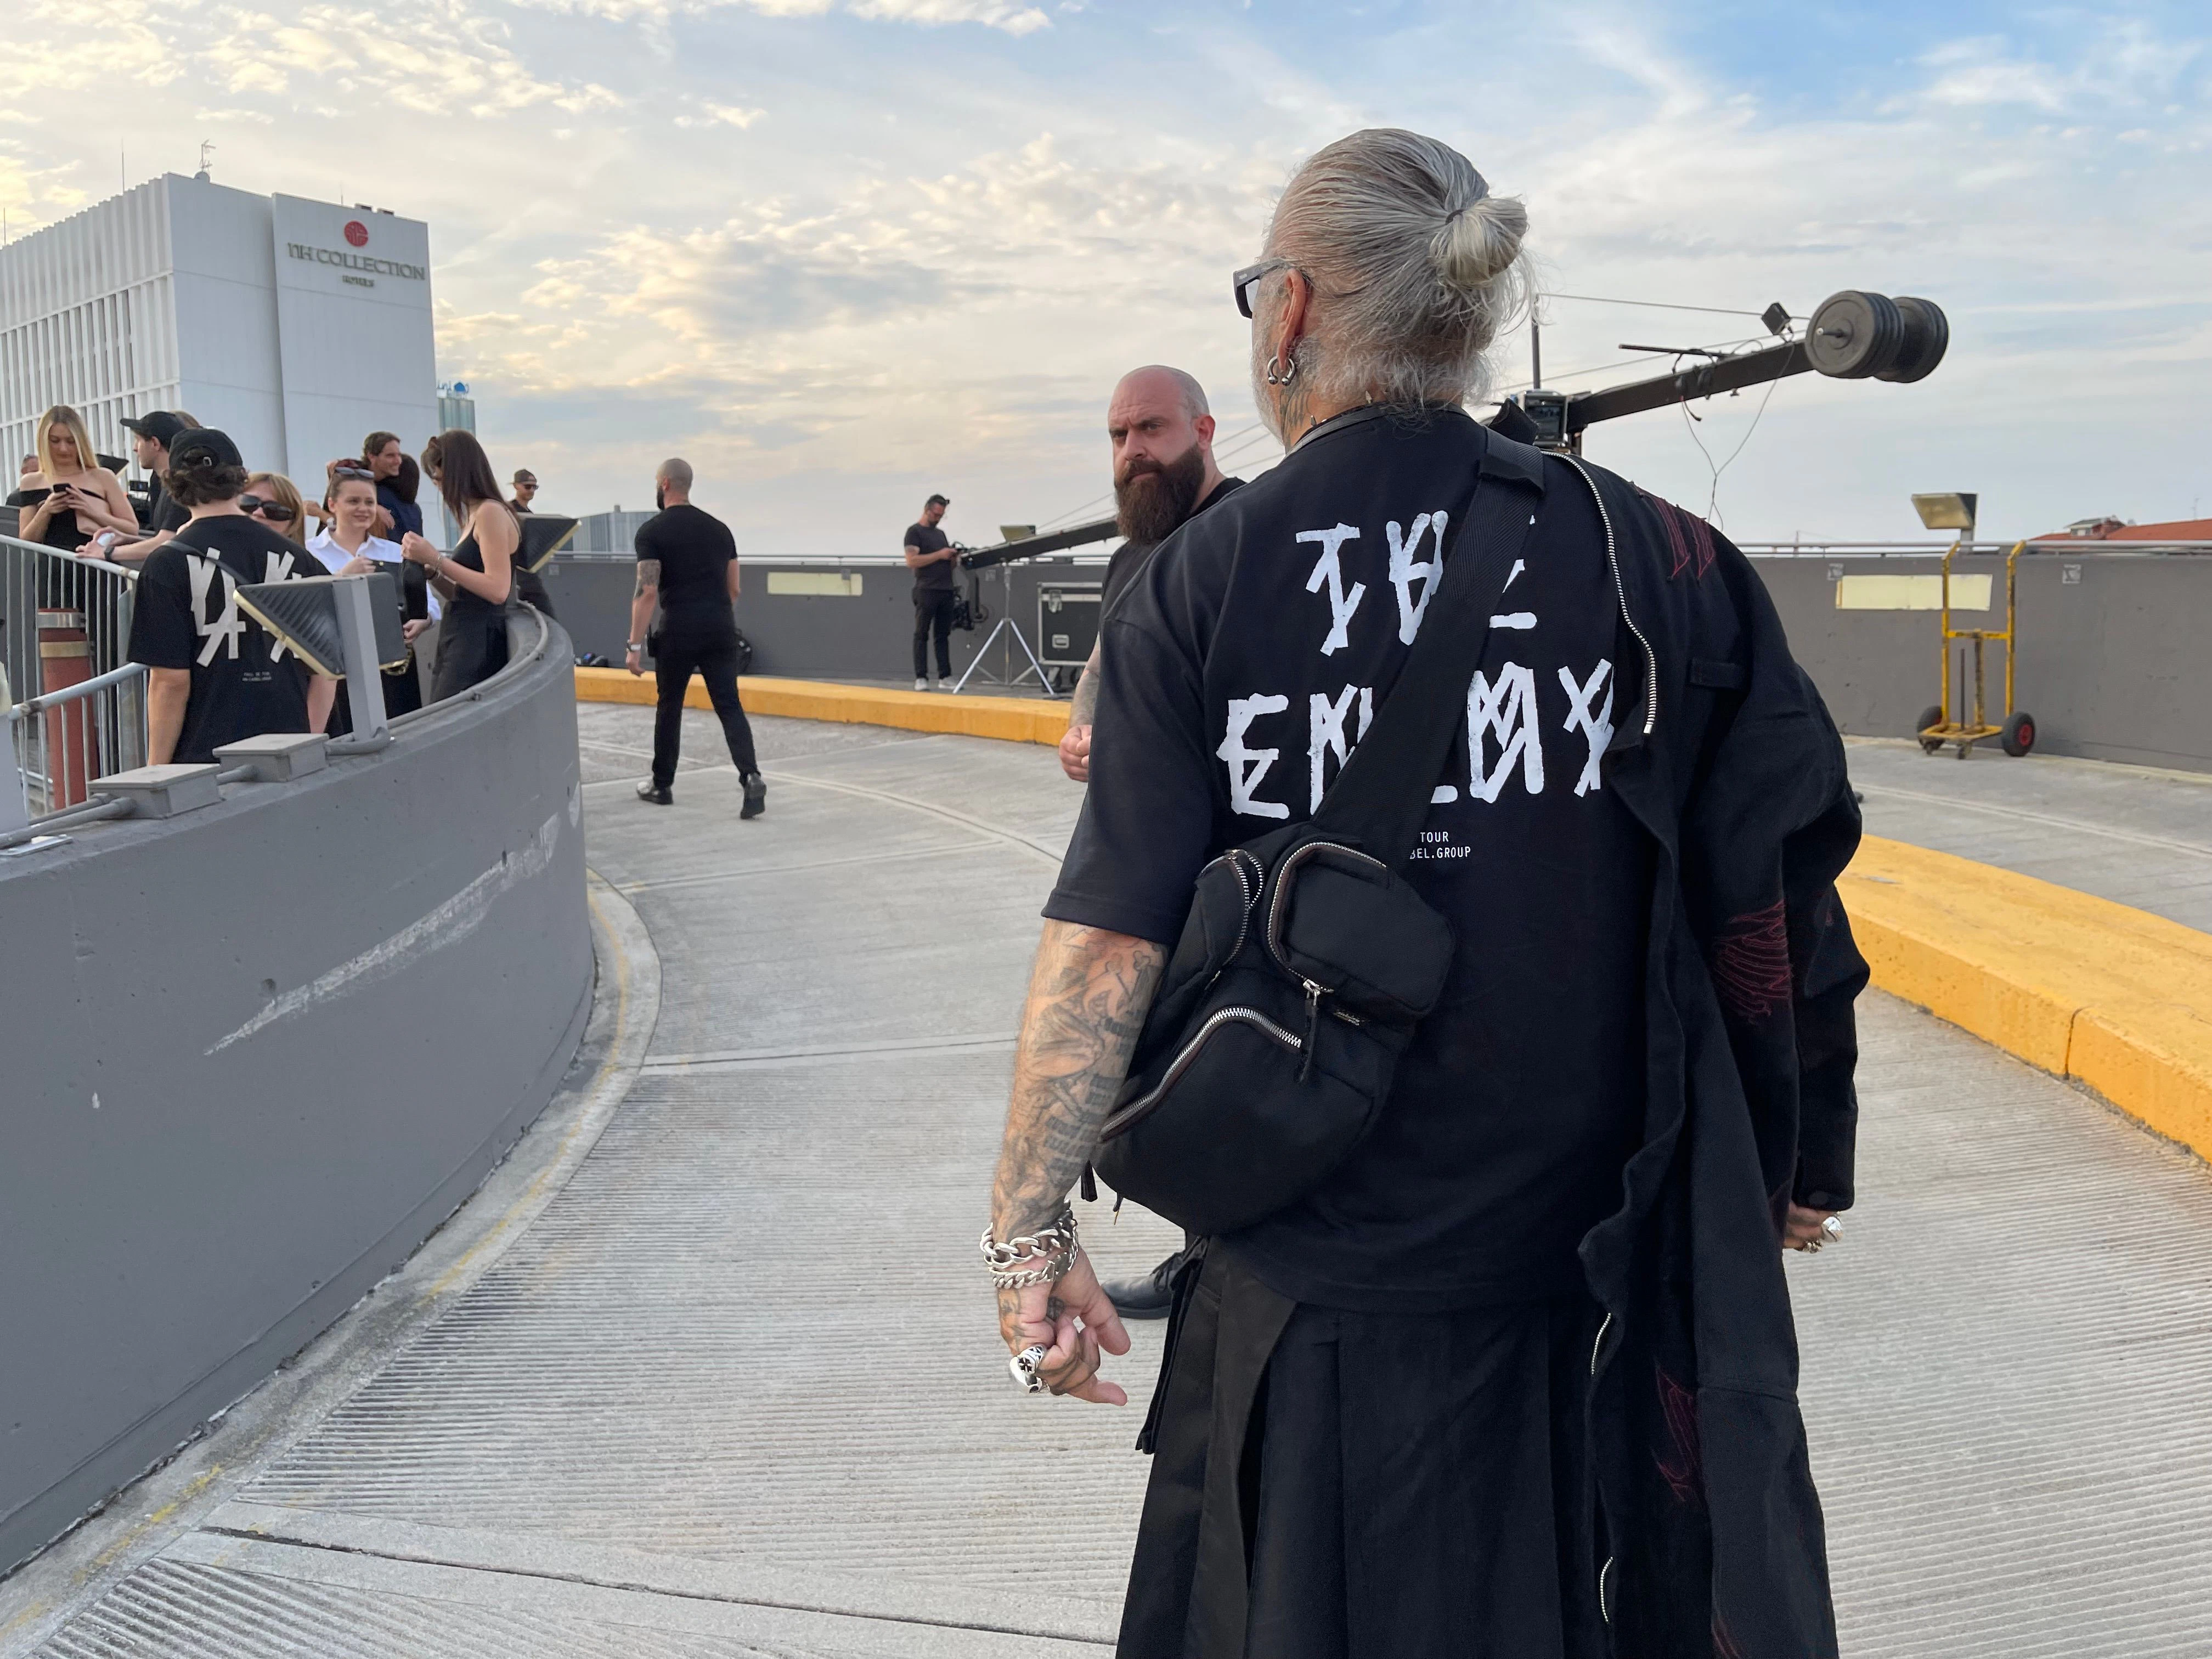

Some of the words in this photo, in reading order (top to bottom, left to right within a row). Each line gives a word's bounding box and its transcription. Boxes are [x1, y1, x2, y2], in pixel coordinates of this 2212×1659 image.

[316, 249, 425, 280] COLLECTION
[1216, 658, 1615, 820] ENMY
[1420, 831, 1449, 843] TOUR
